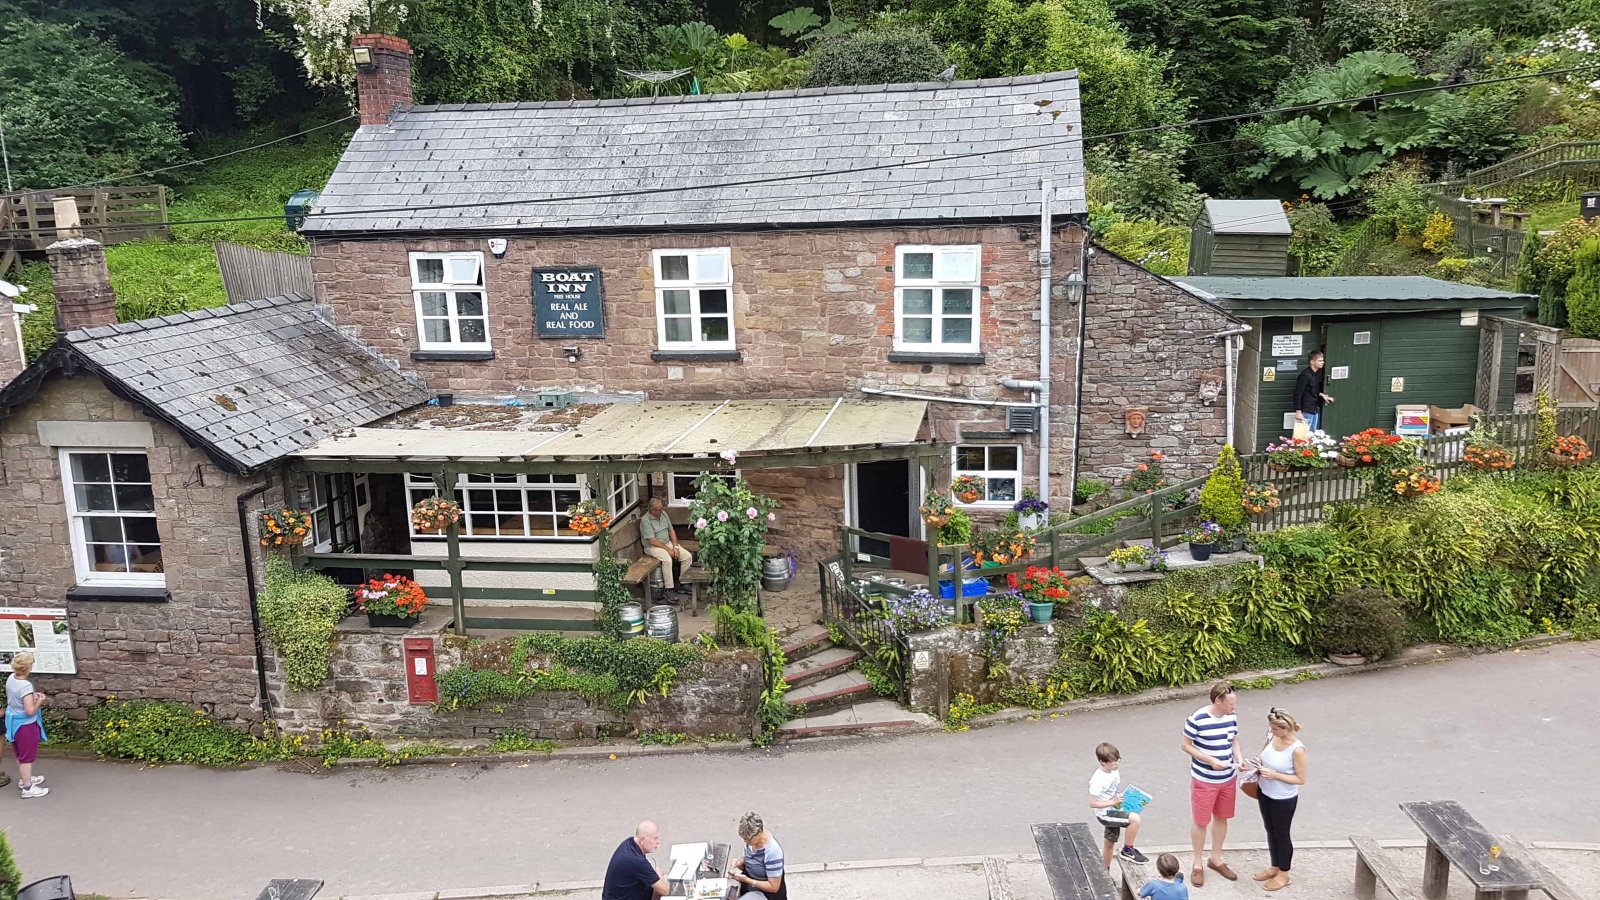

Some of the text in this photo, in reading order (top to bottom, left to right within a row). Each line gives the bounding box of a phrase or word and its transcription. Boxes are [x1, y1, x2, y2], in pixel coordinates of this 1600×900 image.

[541, 273, 594, 281] BOAT
[547, 283, 587, 292] INN
[550, 303, 588, 311] REAL ALE
